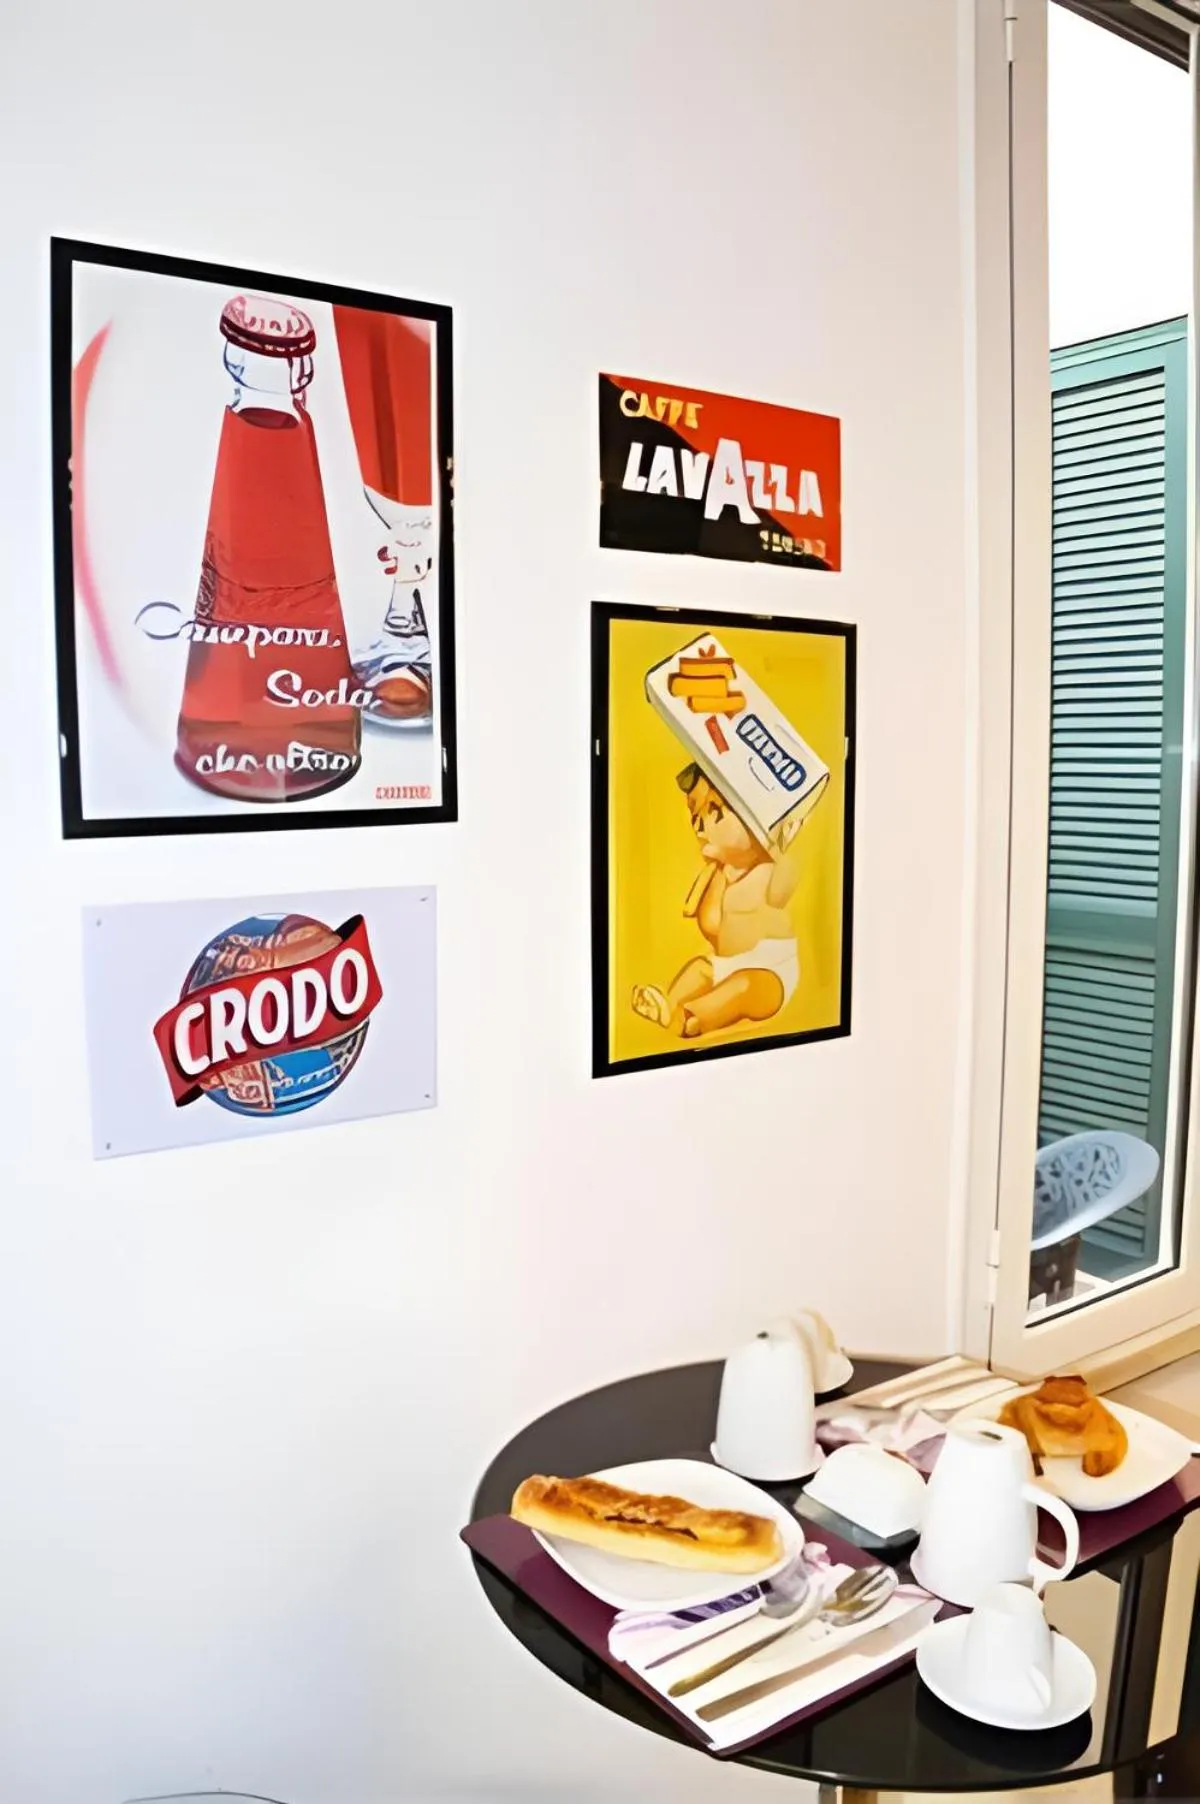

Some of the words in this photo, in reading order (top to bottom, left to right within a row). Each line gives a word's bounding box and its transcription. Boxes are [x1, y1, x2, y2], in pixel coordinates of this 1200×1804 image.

[621, 437, 824, 525] LAVAZZA
[262, 668, 379, 708] Soda
[173, 947, 369, 1076] CRODO
